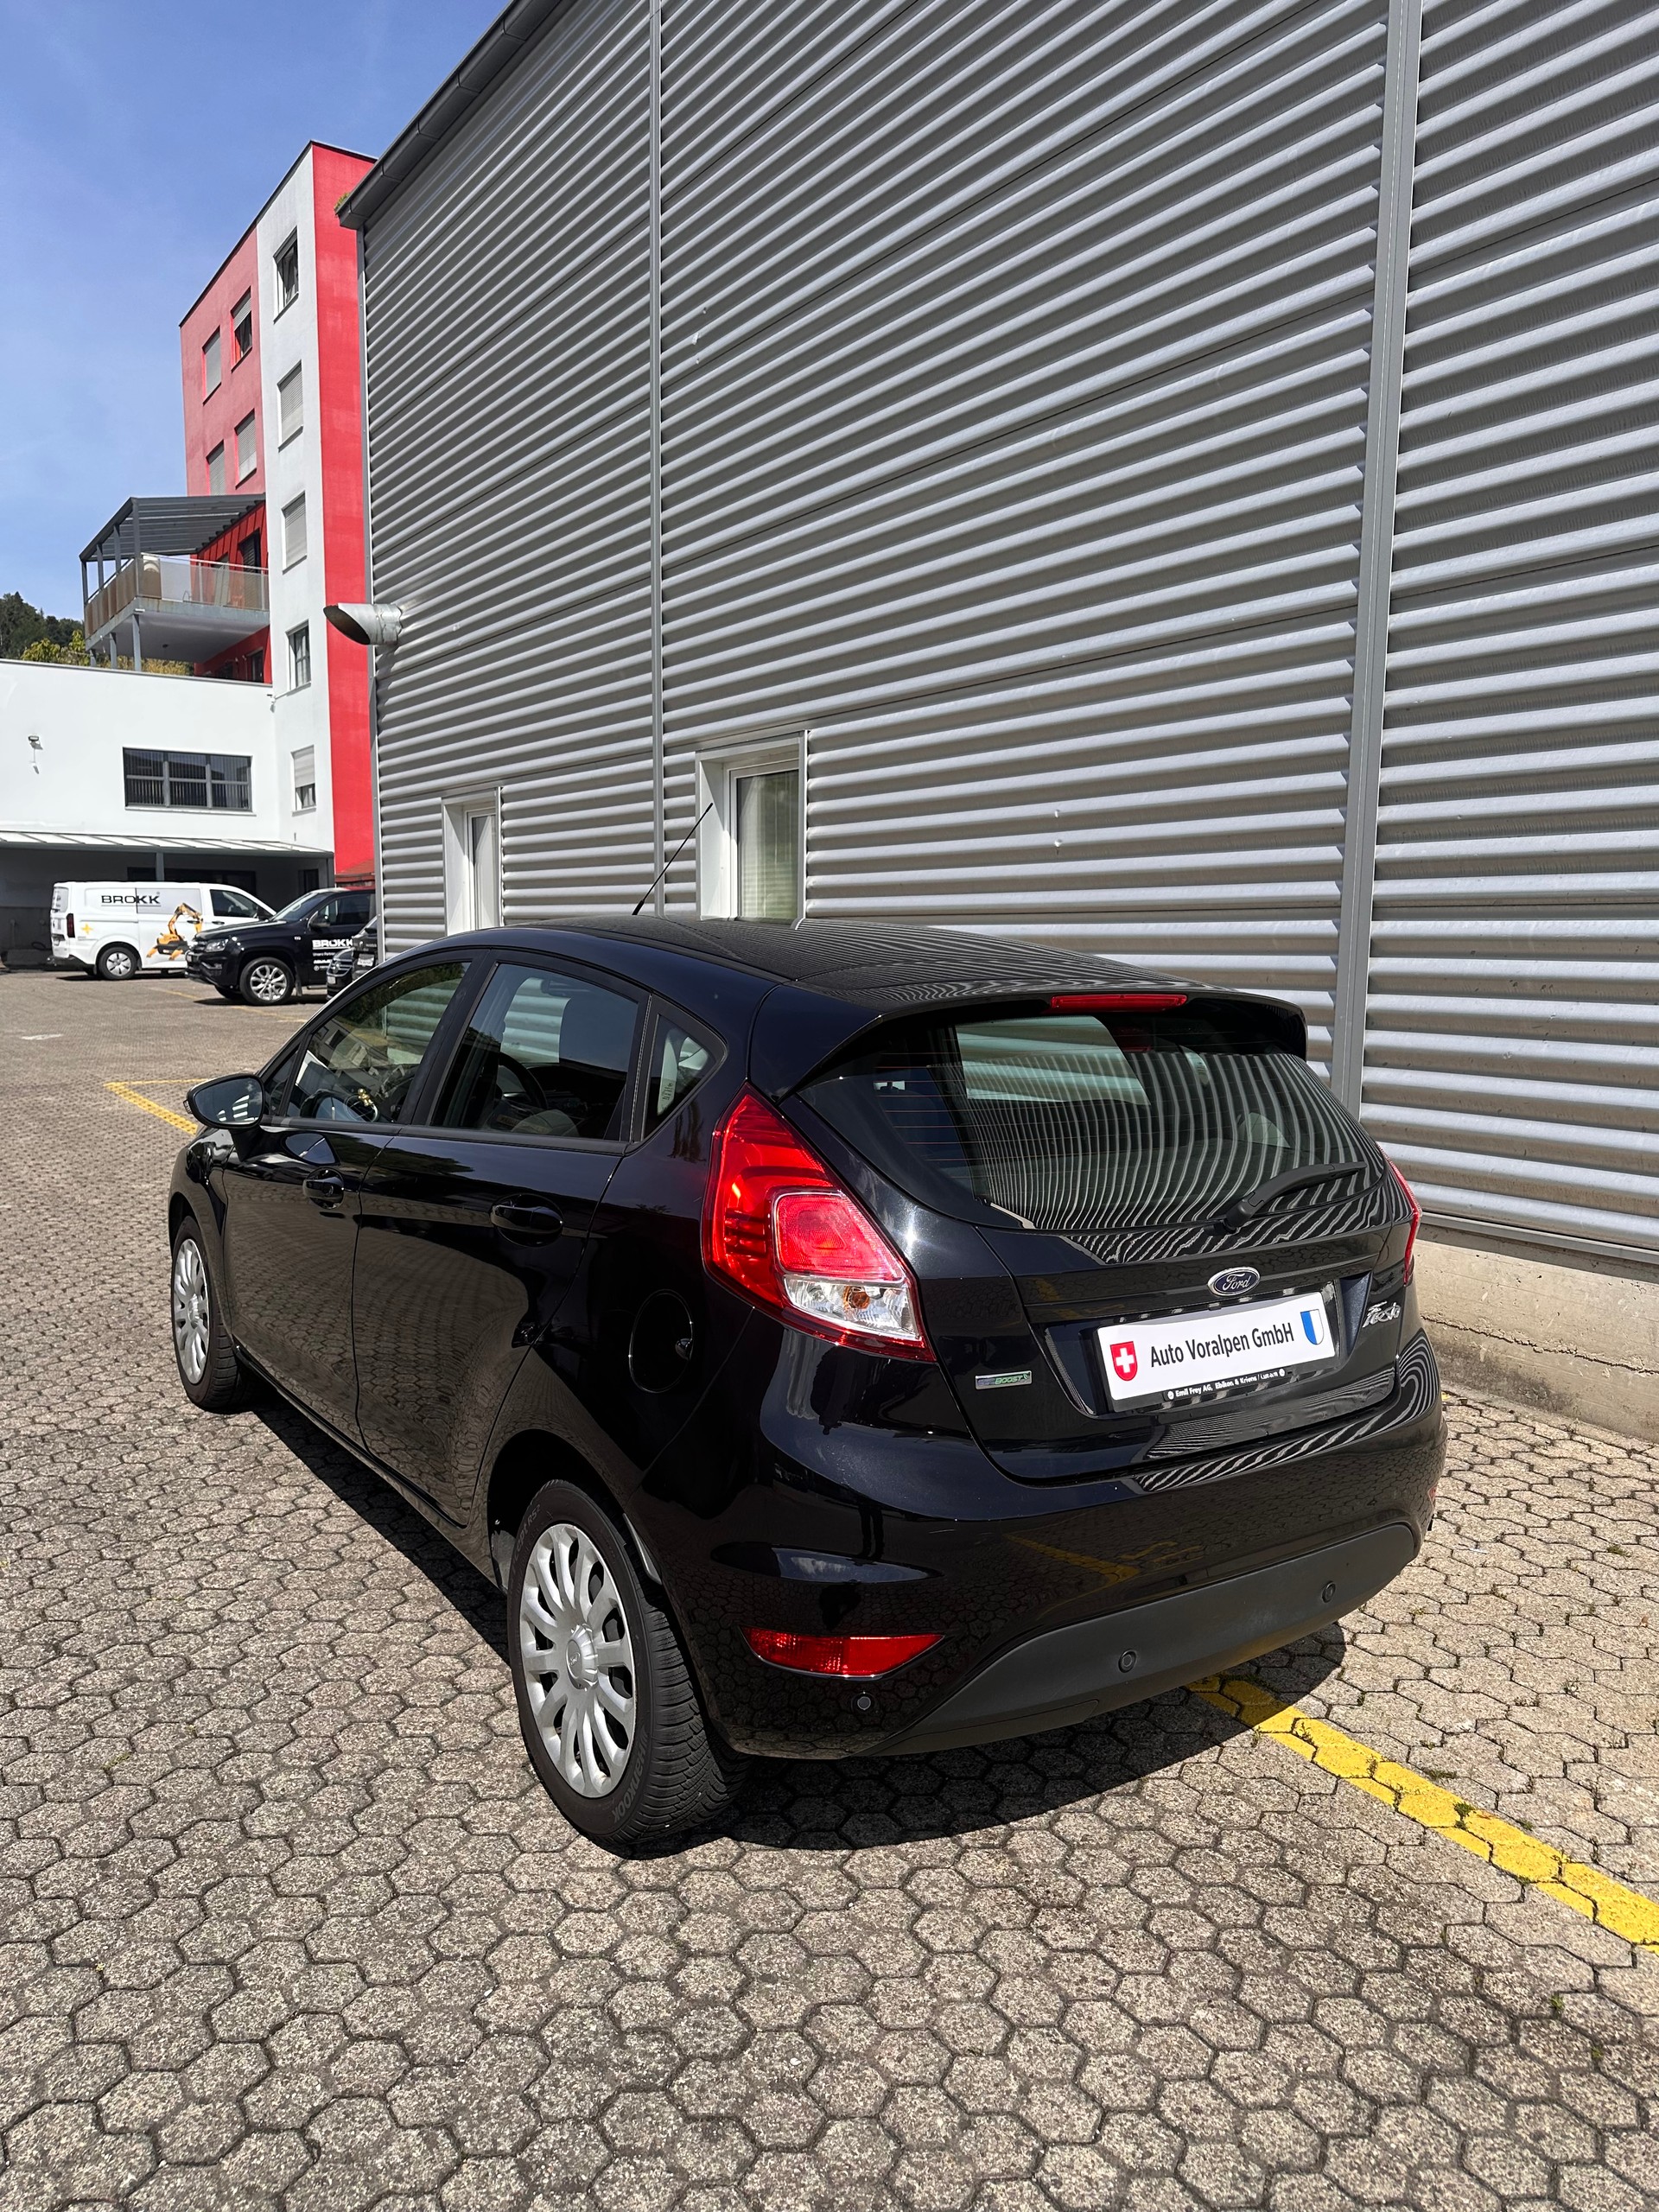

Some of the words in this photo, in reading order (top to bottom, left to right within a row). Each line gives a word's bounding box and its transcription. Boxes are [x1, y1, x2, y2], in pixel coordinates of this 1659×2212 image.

[101, 895, 161, 904] BROKK
[312, 939, 353, 948] BROKK
[1222, 1273, 1252, 1291] Ford
[1151, 1344, 1184, 1368] Auto
[1185, 1334, 1250, 1360] Voralpen
[1251, 1322, 1294, 1348] GmbH
[1189, 1388, 1202, 1396] Frey
[1214, 1381, 1234, 1389] Ebikon
